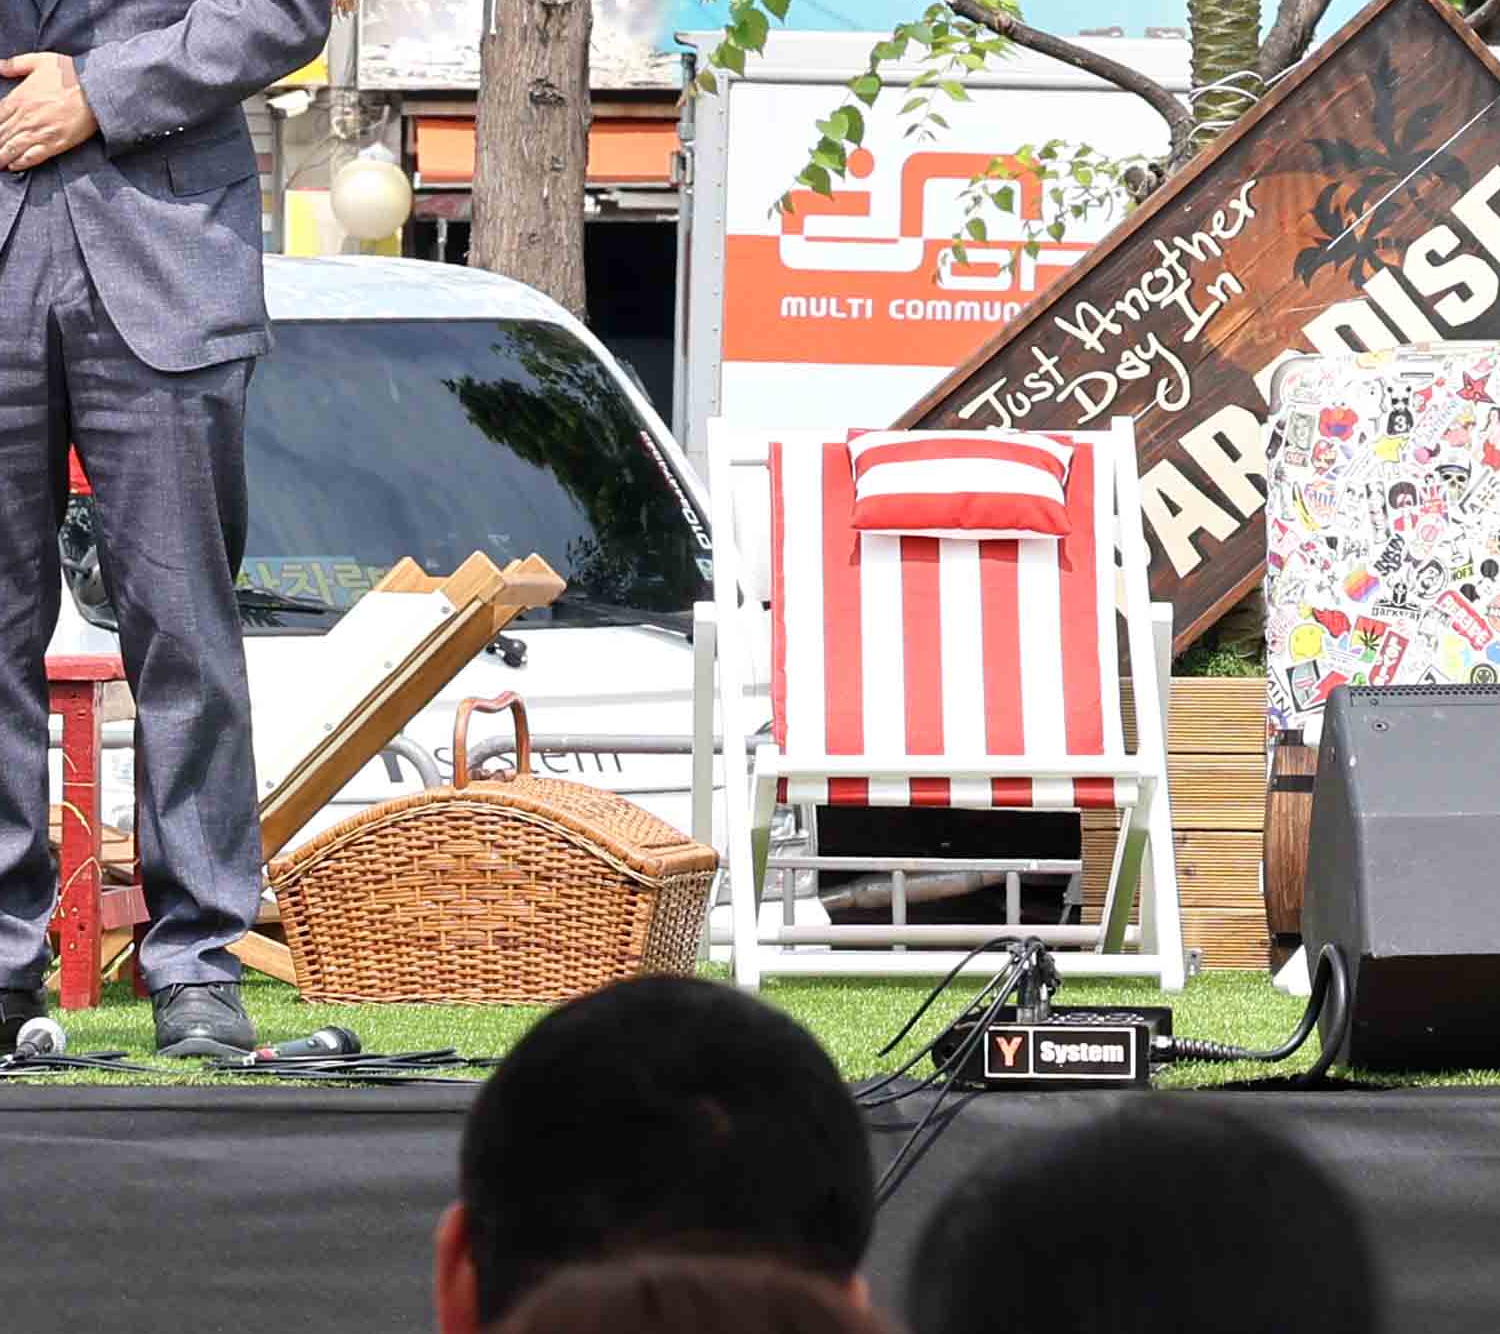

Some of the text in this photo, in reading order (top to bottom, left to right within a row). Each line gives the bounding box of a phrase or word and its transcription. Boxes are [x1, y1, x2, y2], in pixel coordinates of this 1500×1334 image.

[889, 299, 1028, 322] COMMUN
[958, 347, 1063, 429] Just
[1055, 180, 1256, 354] Another
[1056, 271, 1243, 424] Day In
[995, 1035, 1125, 1067] Y System
